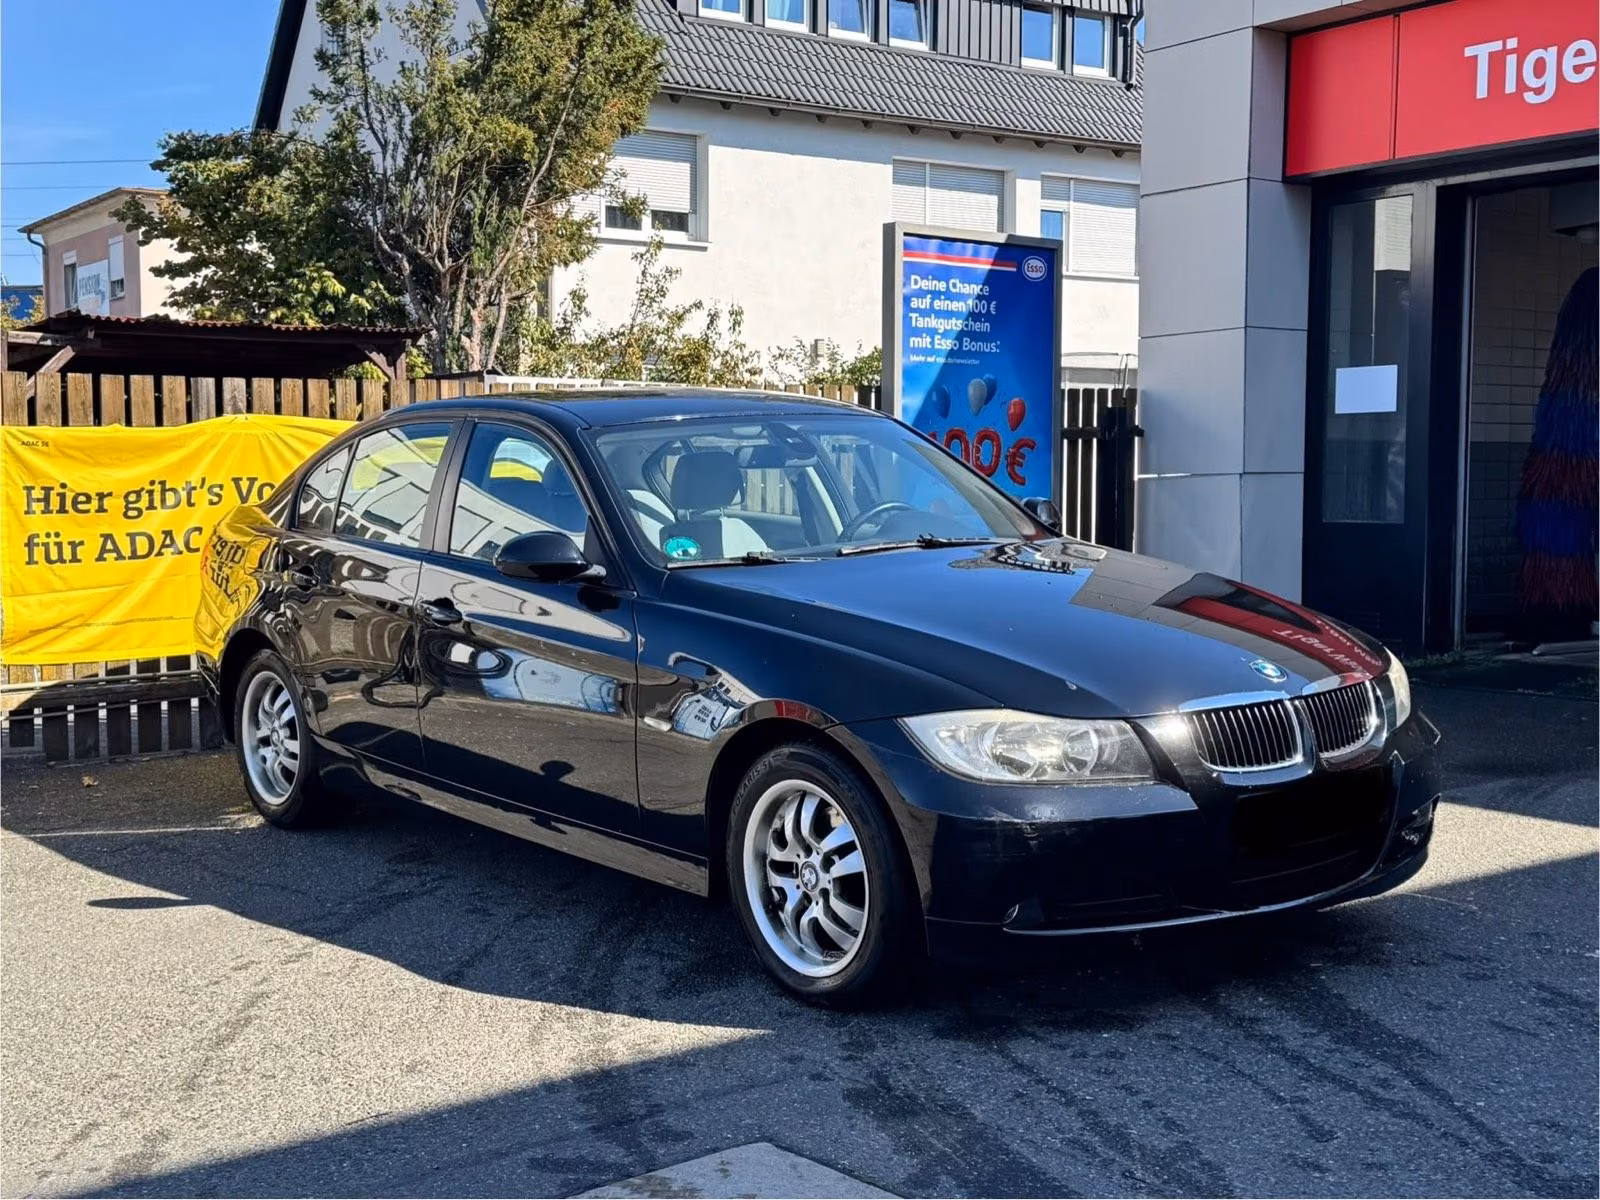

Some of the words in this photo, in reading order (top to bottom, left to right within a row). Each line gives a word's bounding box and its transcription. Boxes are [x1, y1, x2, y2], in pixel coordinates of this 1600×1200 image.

[1463, 36, 1598, 105] Tige
[1026, 262, 1044, 273] Esso
[910, 274, 947, 292] Deine
[948, 278, 990, 296] Chance
[910, 294, 931, 309] auf
[933, 296, 965, 312] einen
[966, 298, 987, 314] 100
[989, 300, 997, 315] €
[909, 312, 991, 333] Tankgutschein
[909, 333, 932, 349] mit
[934, 335, 960, 350] Esso
[22, 482, 113, 516] Hier
[122, 477, 224, 521] gibt's
[24, 531, 85, 566] für
[95, 526, 203, 563] ADAC
